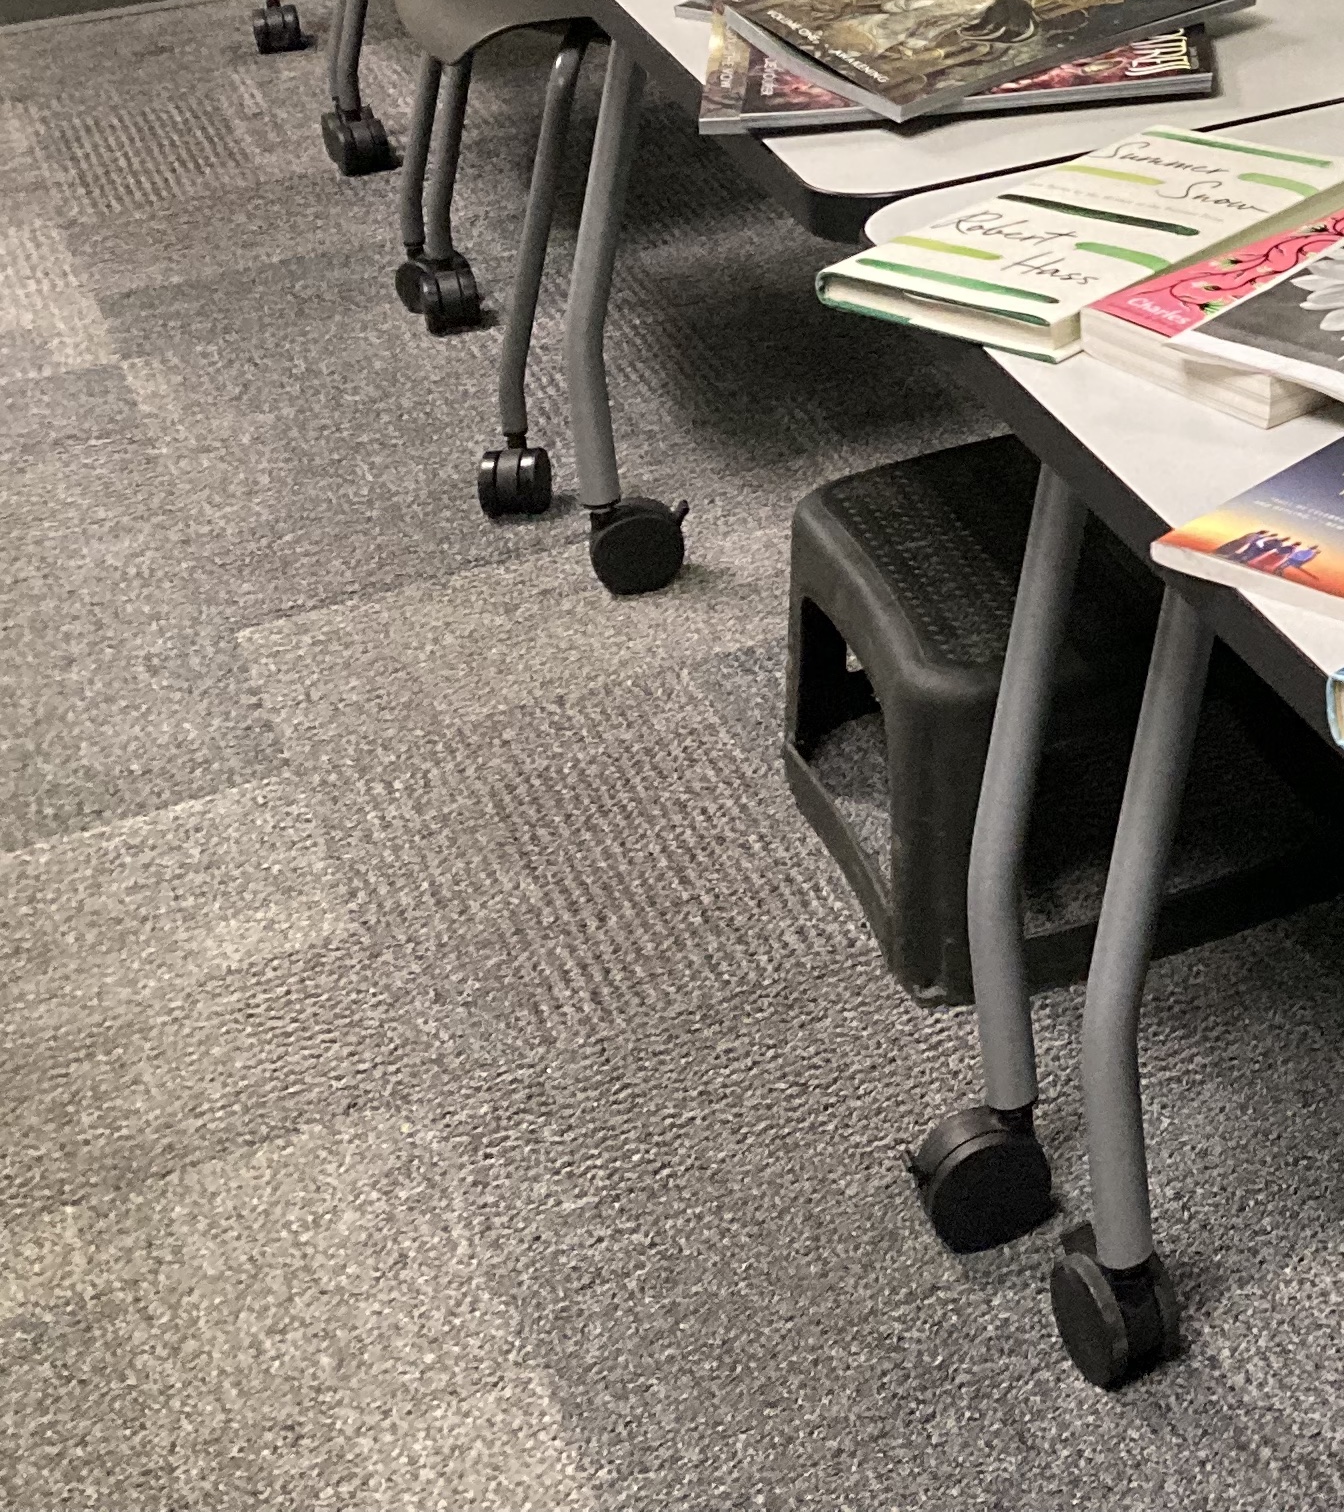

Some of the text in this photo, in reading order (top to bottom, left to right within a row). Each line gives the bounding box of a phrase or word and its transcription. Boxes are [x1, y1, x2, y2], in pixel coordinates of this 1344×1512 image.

[1091, 140, 1230, 178] Summer
[1160, 179, 1268, 214] Snow
[931, 210, 1078, 246] Robert
[1001, 250, 1100, 288] Hass
[1126, 297, 1192, 326] Charles
